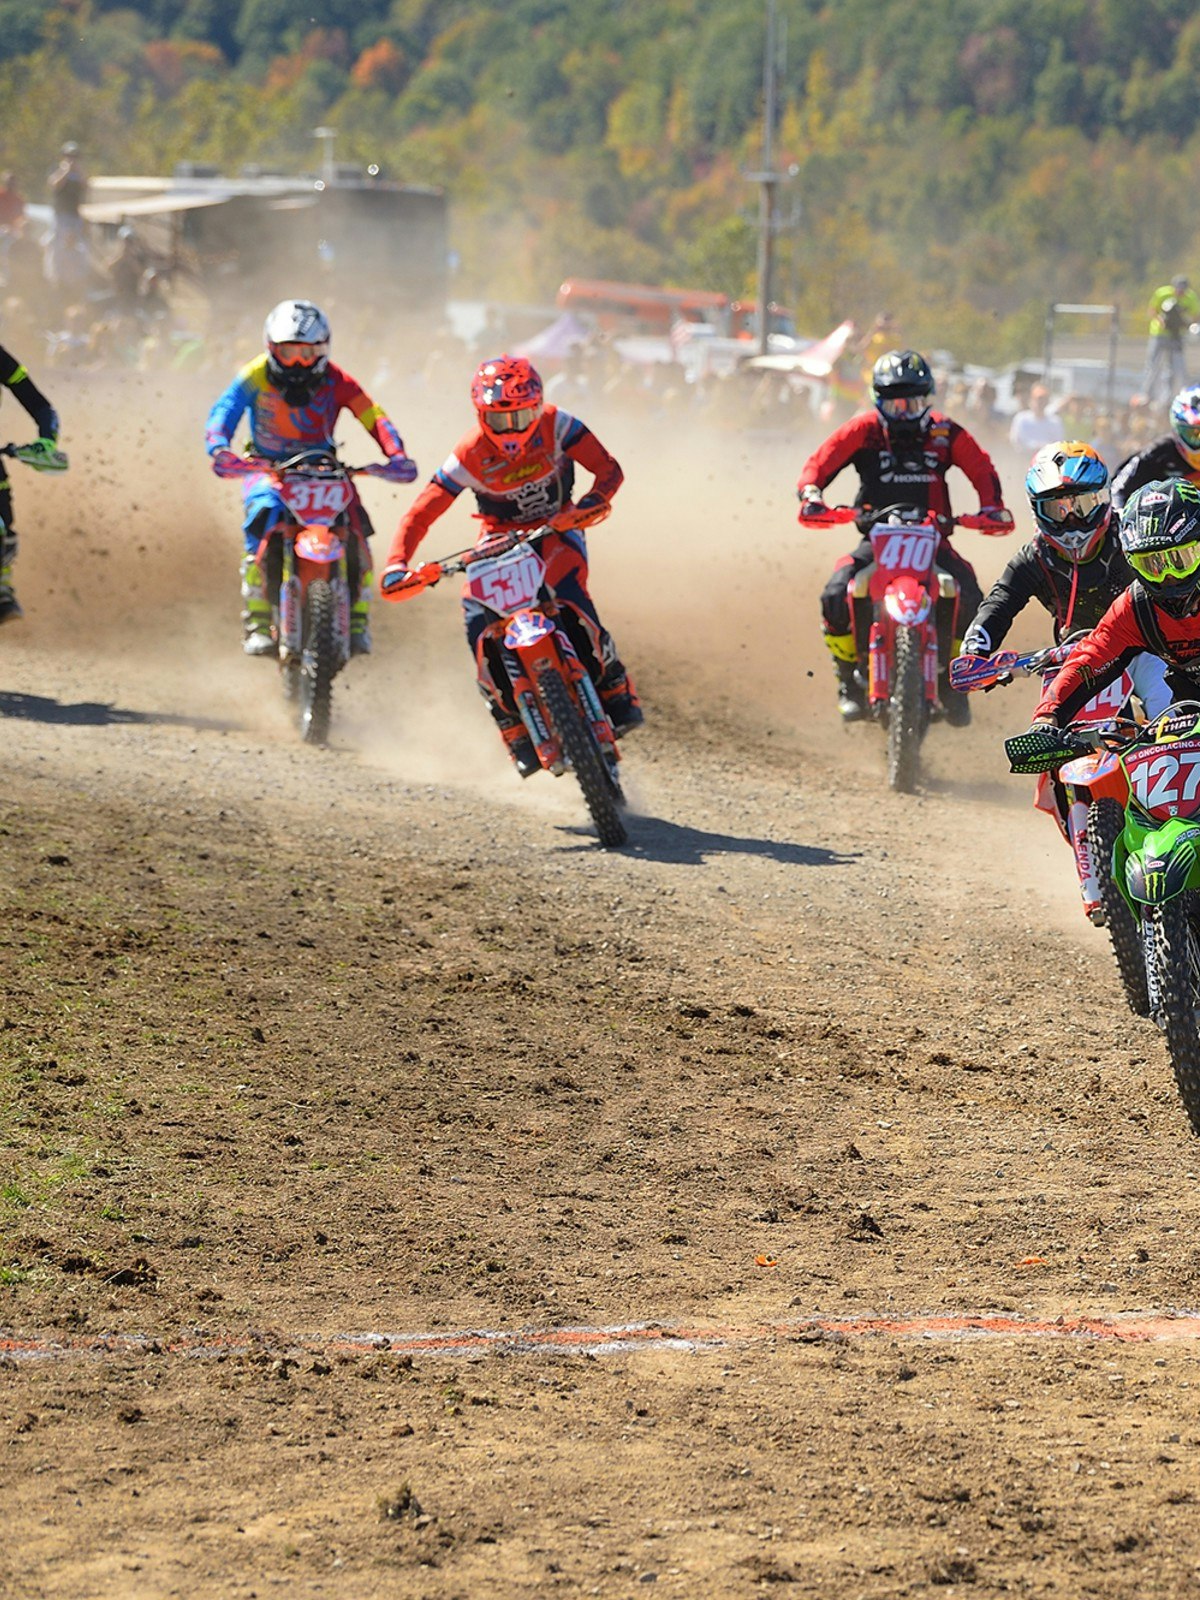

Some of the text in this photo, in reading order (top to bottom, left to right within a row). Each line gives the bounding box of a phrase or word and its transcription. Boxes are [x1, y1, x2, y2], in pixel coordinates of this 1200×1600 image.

[893, 474, 937, 483] HONDA
[289, 485, 343, 511] 314
[880, 535, 934, 572] 410
[481, 556, 541, 609] 530
